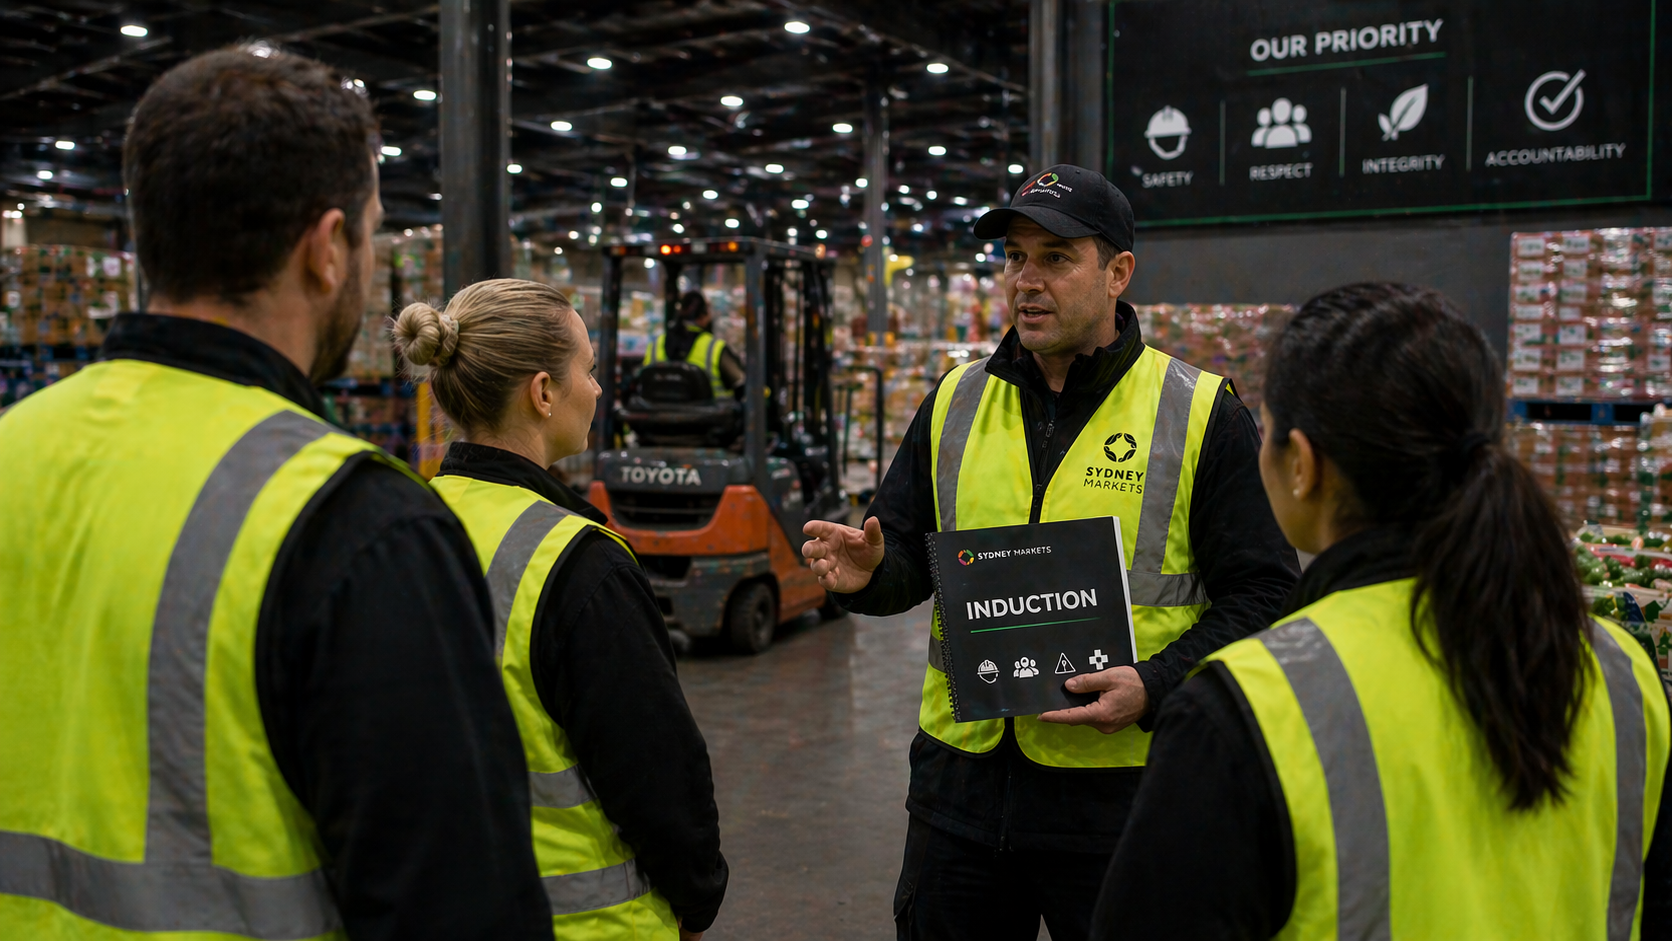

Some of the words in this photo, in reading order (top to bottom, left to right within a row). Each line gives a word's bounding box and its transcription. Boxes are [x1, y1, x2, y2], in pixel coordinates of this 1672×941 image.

[1250, 36, 1307, 62] OUR
[1315, 19, 1443, 55] PRIORITY
[1362, 153, 1446, 175] INTEGRITY
[1485, 142, 1627, 168] ACCOUNTABILITY
[1141, 171, 1193, 188] SAFETY
[1249, 162, 1313, 181] RESPECT
[620, 466, 701, 485] TOYOTA
[1086, 466, 1144, 481] SYDNEY
[1084, 478, 1143, 494] MARKETS
[977, 550, 1011, 560] SYDNEY
[1013, 546, 1052, 556] MARKETS
[966, 588, 1098, 620] INDUCTION
